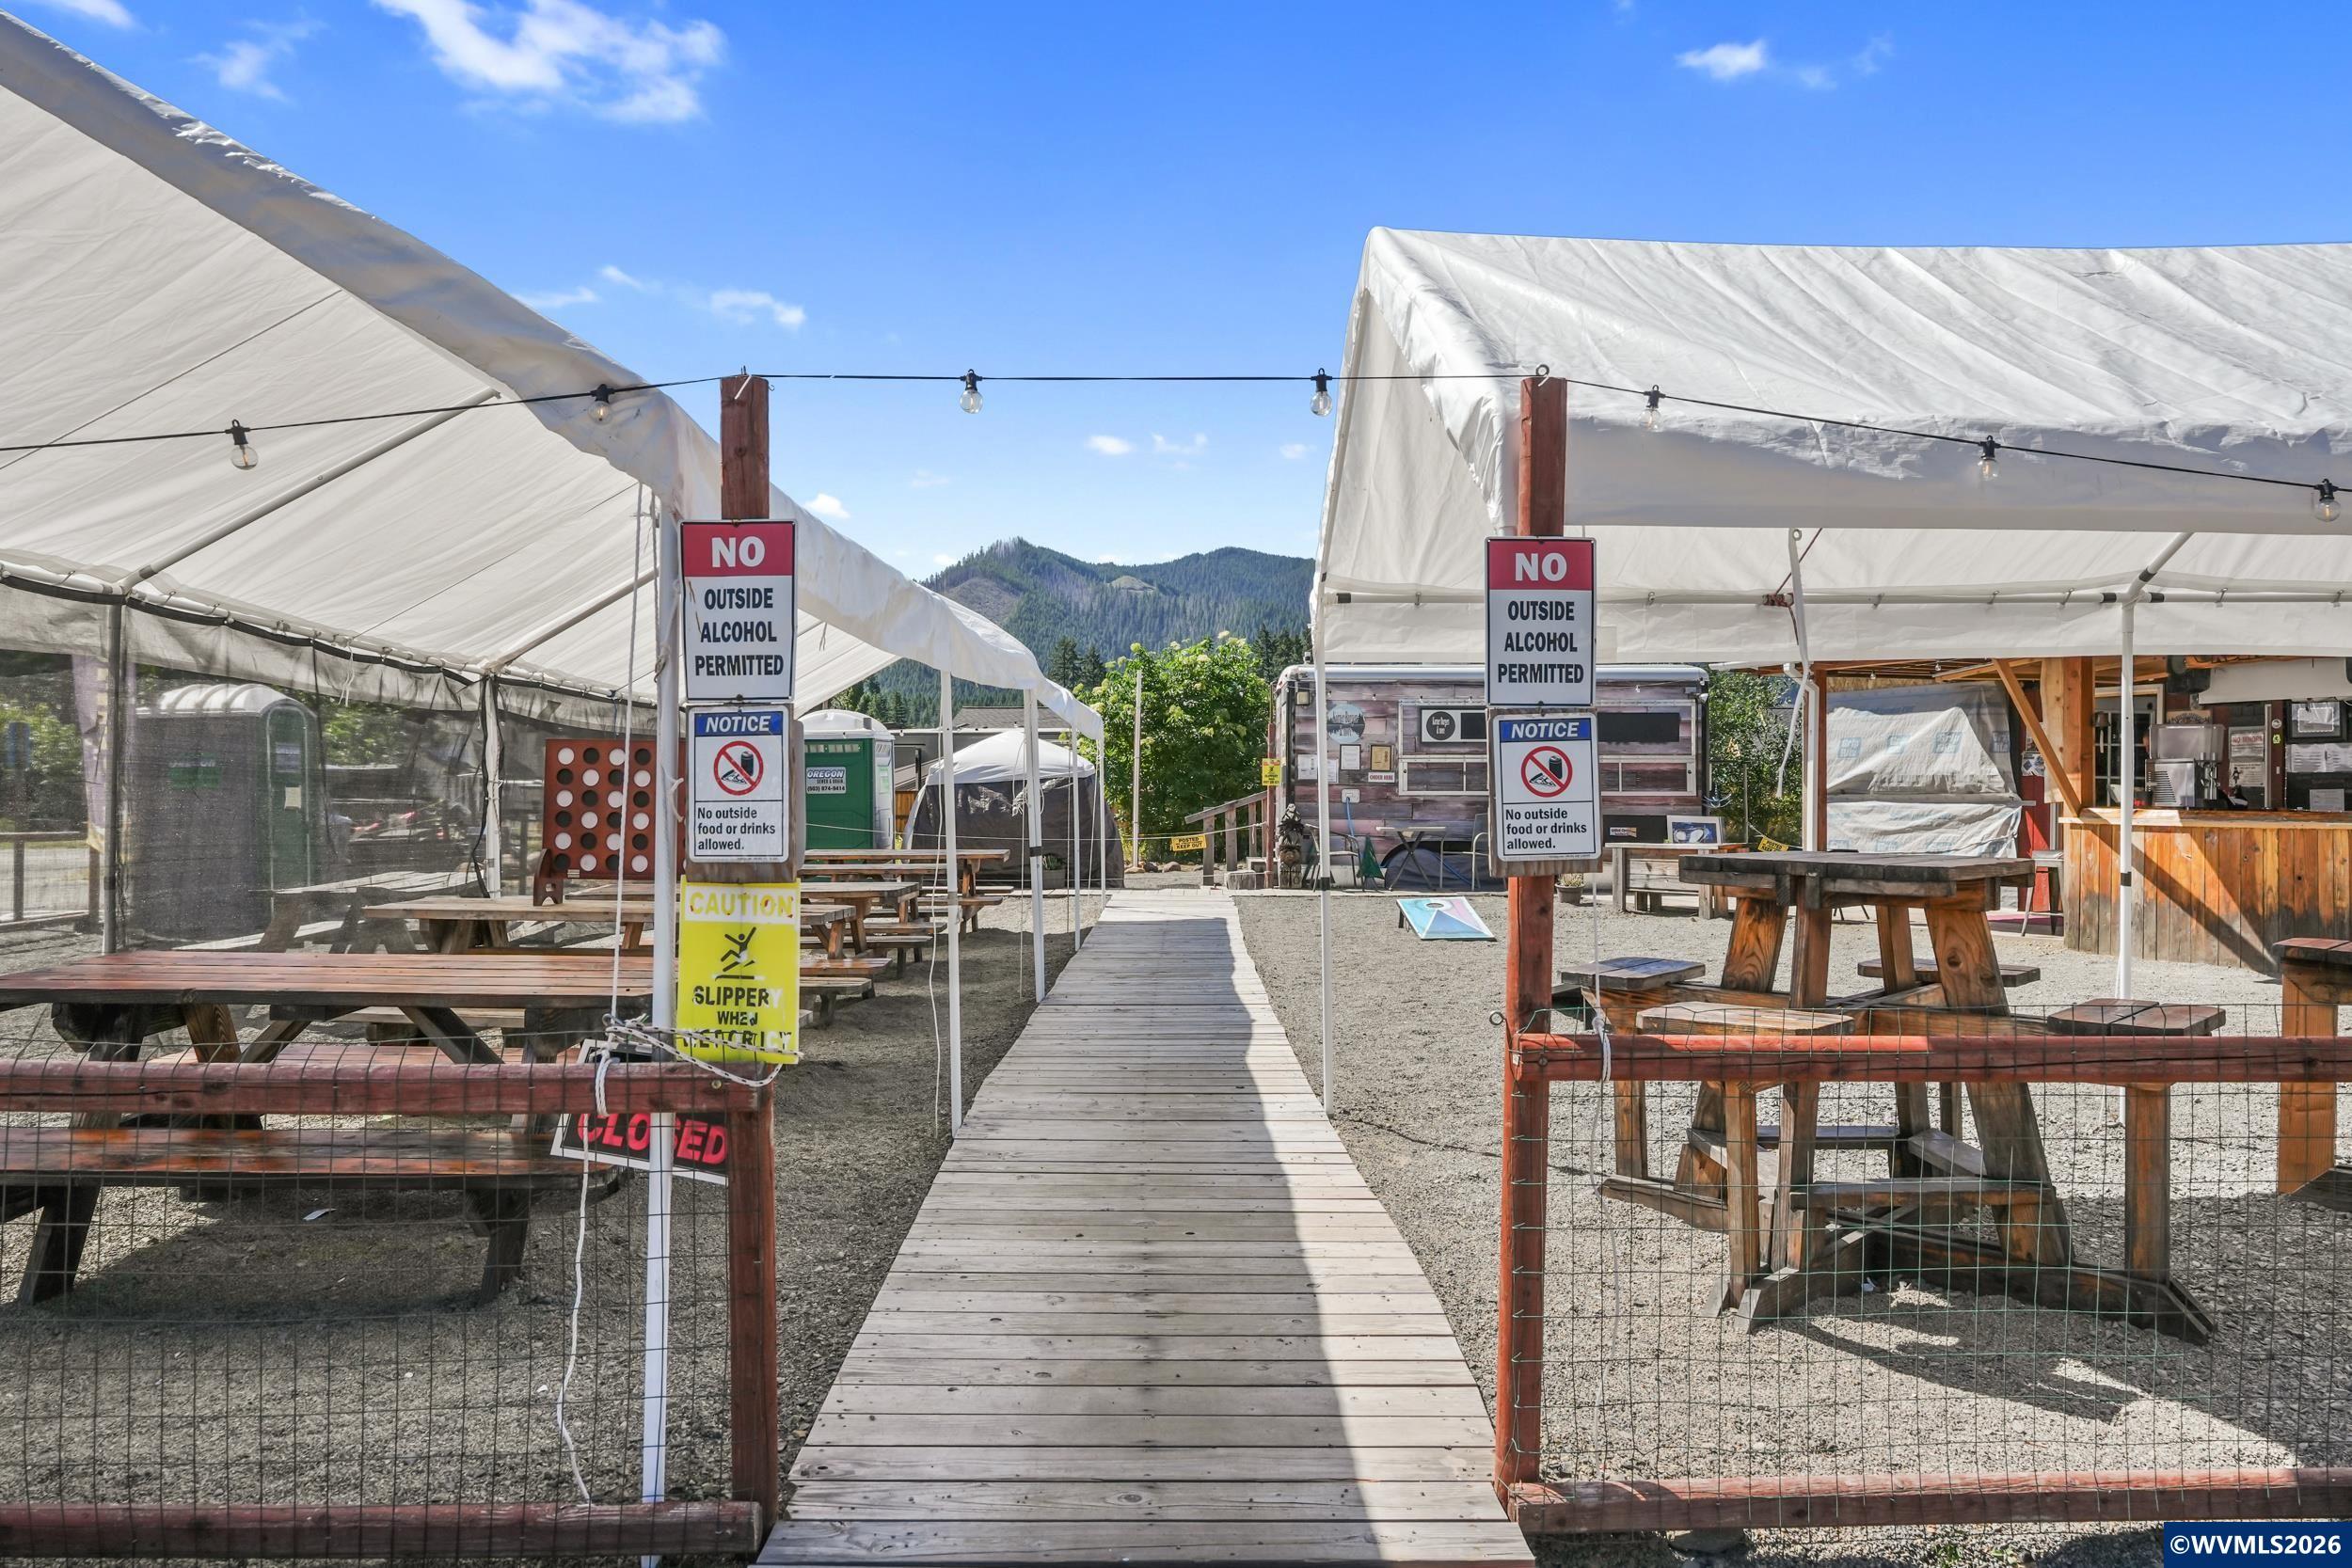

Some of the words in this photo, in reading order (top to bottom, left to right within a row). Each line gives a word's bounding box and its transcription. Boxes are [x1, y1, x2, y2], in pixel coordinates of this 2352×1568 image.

[711, 536, 766, 567] NO
[1515, 552, 1567, 581] NO
[704, 587, 773, 610] OUTSIDE
[1507, 600, 1575, 622] OUTSIDE
[700, 621, 777, 643] ALCOHOL
[1504, 631, 1578, 653] ALCOHOL
[694, 655, 784, 676] PERMITTED
[1498, 663, 1584, 684] PERMITTED
[705, 715, 771, 733] NOTICE
[1510, 721, 1580, 738] NOTICE
[807, 769, 844, 779] OREGON
[698, 807, 713, 819] No
[716, 807, 757, 819] outside
[1506, 809, 1521, 820] No
[1524, 808, 1567, 820] outside
[698, 822, 723, 834] food
[726, 825, 738, 834] or
[740, 821, 775, 834] drinks
[1506, 823, 1533, 834] food
[1535, 826, 1548, 834] or
[1549, 822, 1587, 834] drinks
[698, 838, 745, 850] allowed.
[1506, 837, 1556, 849] allowed.
[690, 891, 793, 919] CAUTION
[692, 985, 783, 1009] SLIPPERY
[717, 1011, 758, 1026] WHEN
